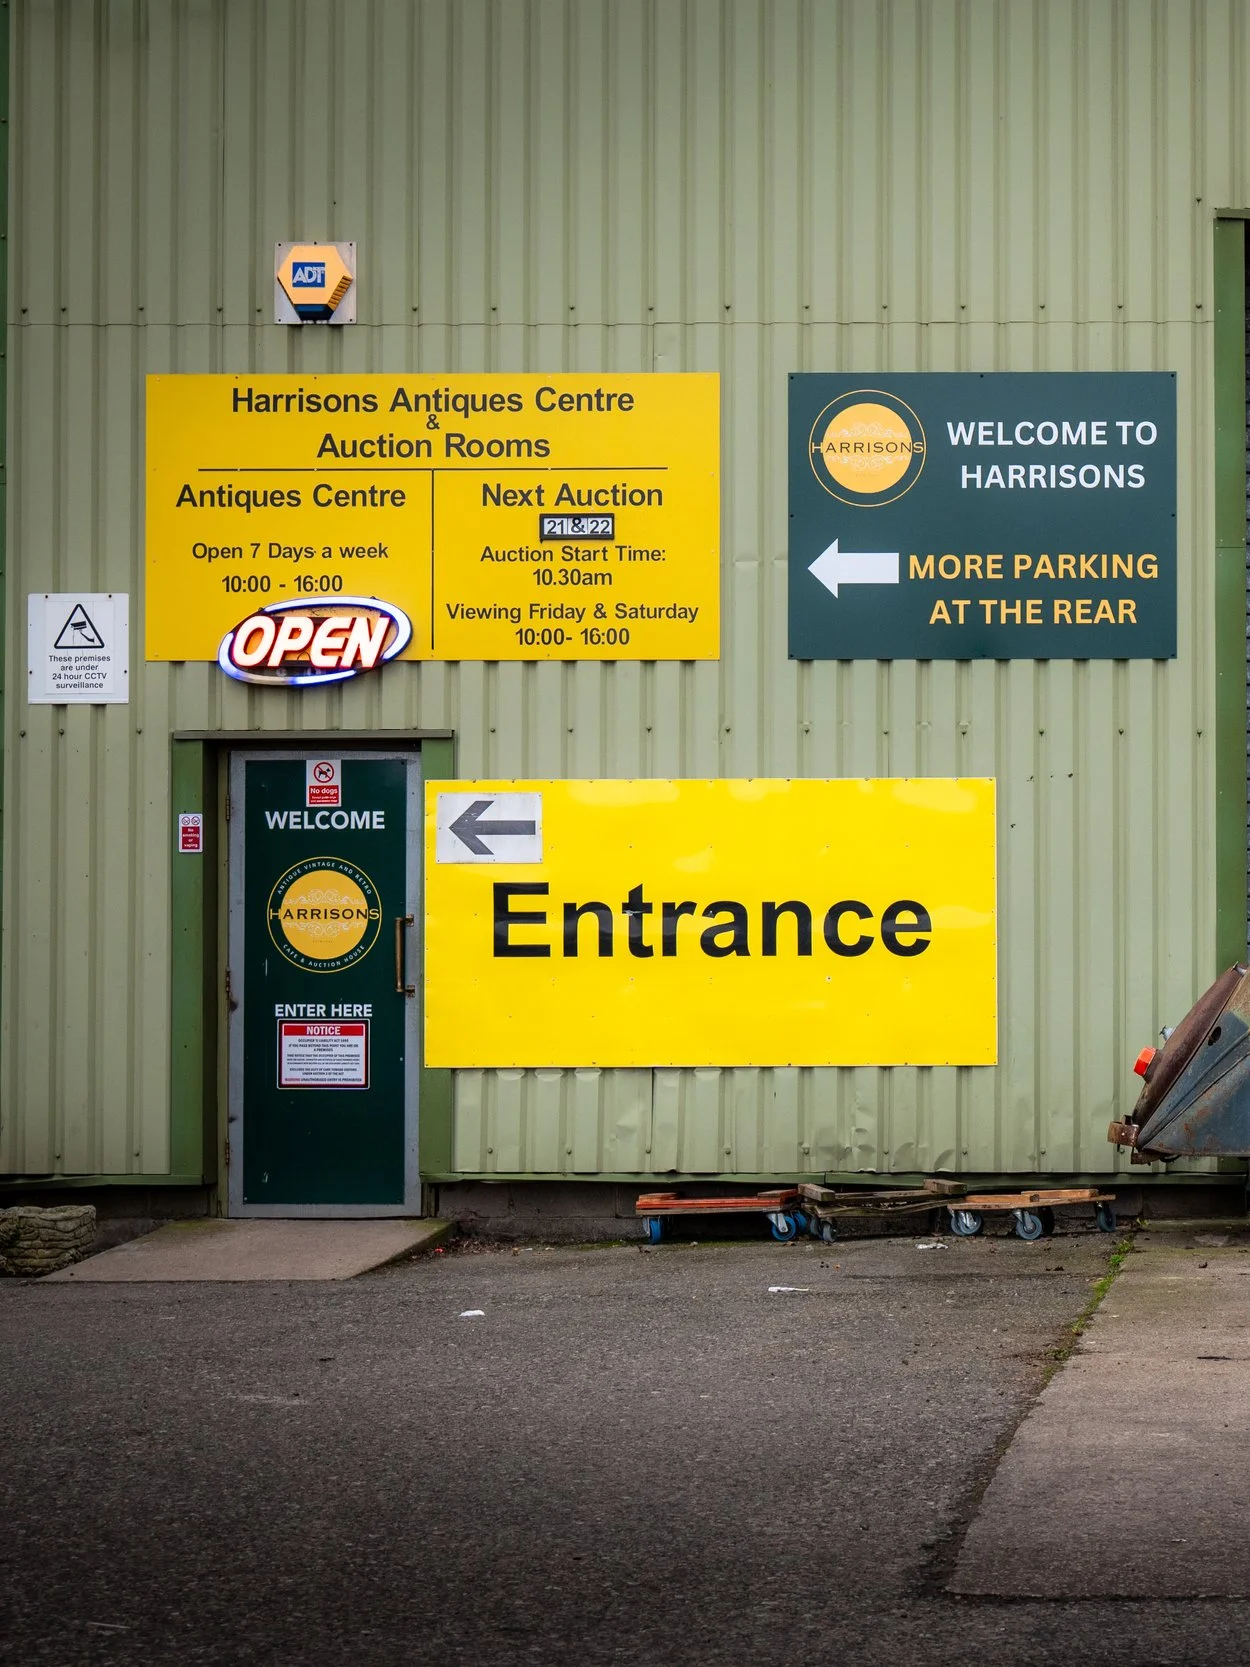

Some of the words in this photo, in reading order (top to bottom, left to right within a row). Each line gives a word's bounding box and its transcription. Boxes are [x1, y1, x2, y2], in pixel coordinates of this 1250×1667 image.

[292, 266, 325, 284] ADT
[232, 387, 379, 413] Harrisons
[389, 387, 524, 419] Antiques
[535, 386, 635, 412] Centre
[426, 414, 440, 430] &
[947, 421, 1107, 446] WELCOME
[1116, 420, 1158, 445] TO
[316, 433, 432, 458] Auction
[445, 433, 551, 458] Rooms
[810, 440, 925, 454] HARRISONS
[961, 463, 1146, 489] HARRISONS
[175, 484, 302, 513] Antiques
[312, 483, 406, 508] Centre
[481, 483, 545, 507] Next
[554, 483, 663, 506] Auction
[192, 542, 243, 563] Open
[250, 543, 261, 559] 7
[268, 542, 314, 563] Days
[321, 547, 332, 559] a
[339, 542, 389, 559] week
[480, 545, 553, 562] Auction
[561, 545, 608, 562] Start
[615, 545, 667, 562] Time:
[532, 568, 613, 586] 10.30am
[909, 554, 1003, 580] MORE
[1013, 553, 1159, 580] PARKING
[221, 575, 271, 593] 10:00
[293, 575, 343, 592] 16:00
[445, 604, 521, 624] Viewing
[529, 603, 586, 623] Friday
[593, 603, 607, 620] &
[615, 602, 699, 623] Saturday
[929, 599, 970, 625] AT
[979, 599, 1043, 625] THE
[1053, 599, 1138, 625] REAR
[231, 614, 391, 669] OPEN
[580, 628, 630, 645] 16:00
[75, 655, 111, 663] premises
[265, 811, 386, 830] WELCOME
[277, 868, 302, 895] ANTIQUE
[303, 861, 336, 871] VINTAGE
[338, 864, 354, 875] AND
[354, 873, 372, 895] RETRO
[269, 908, 380, 920] HARRISONS
[492, 881, 933, 960] Entrance
[283, 943, 298, 959] CAFE
[308, 960, 341, 968] AUCTION
[343, 944, 365, 963] HOUSE
[274, 1003, 327, 1017] ENTER
[330, 1003, 373, 1017] HERE
[306, 1026, 341, 1035] NOTICE
